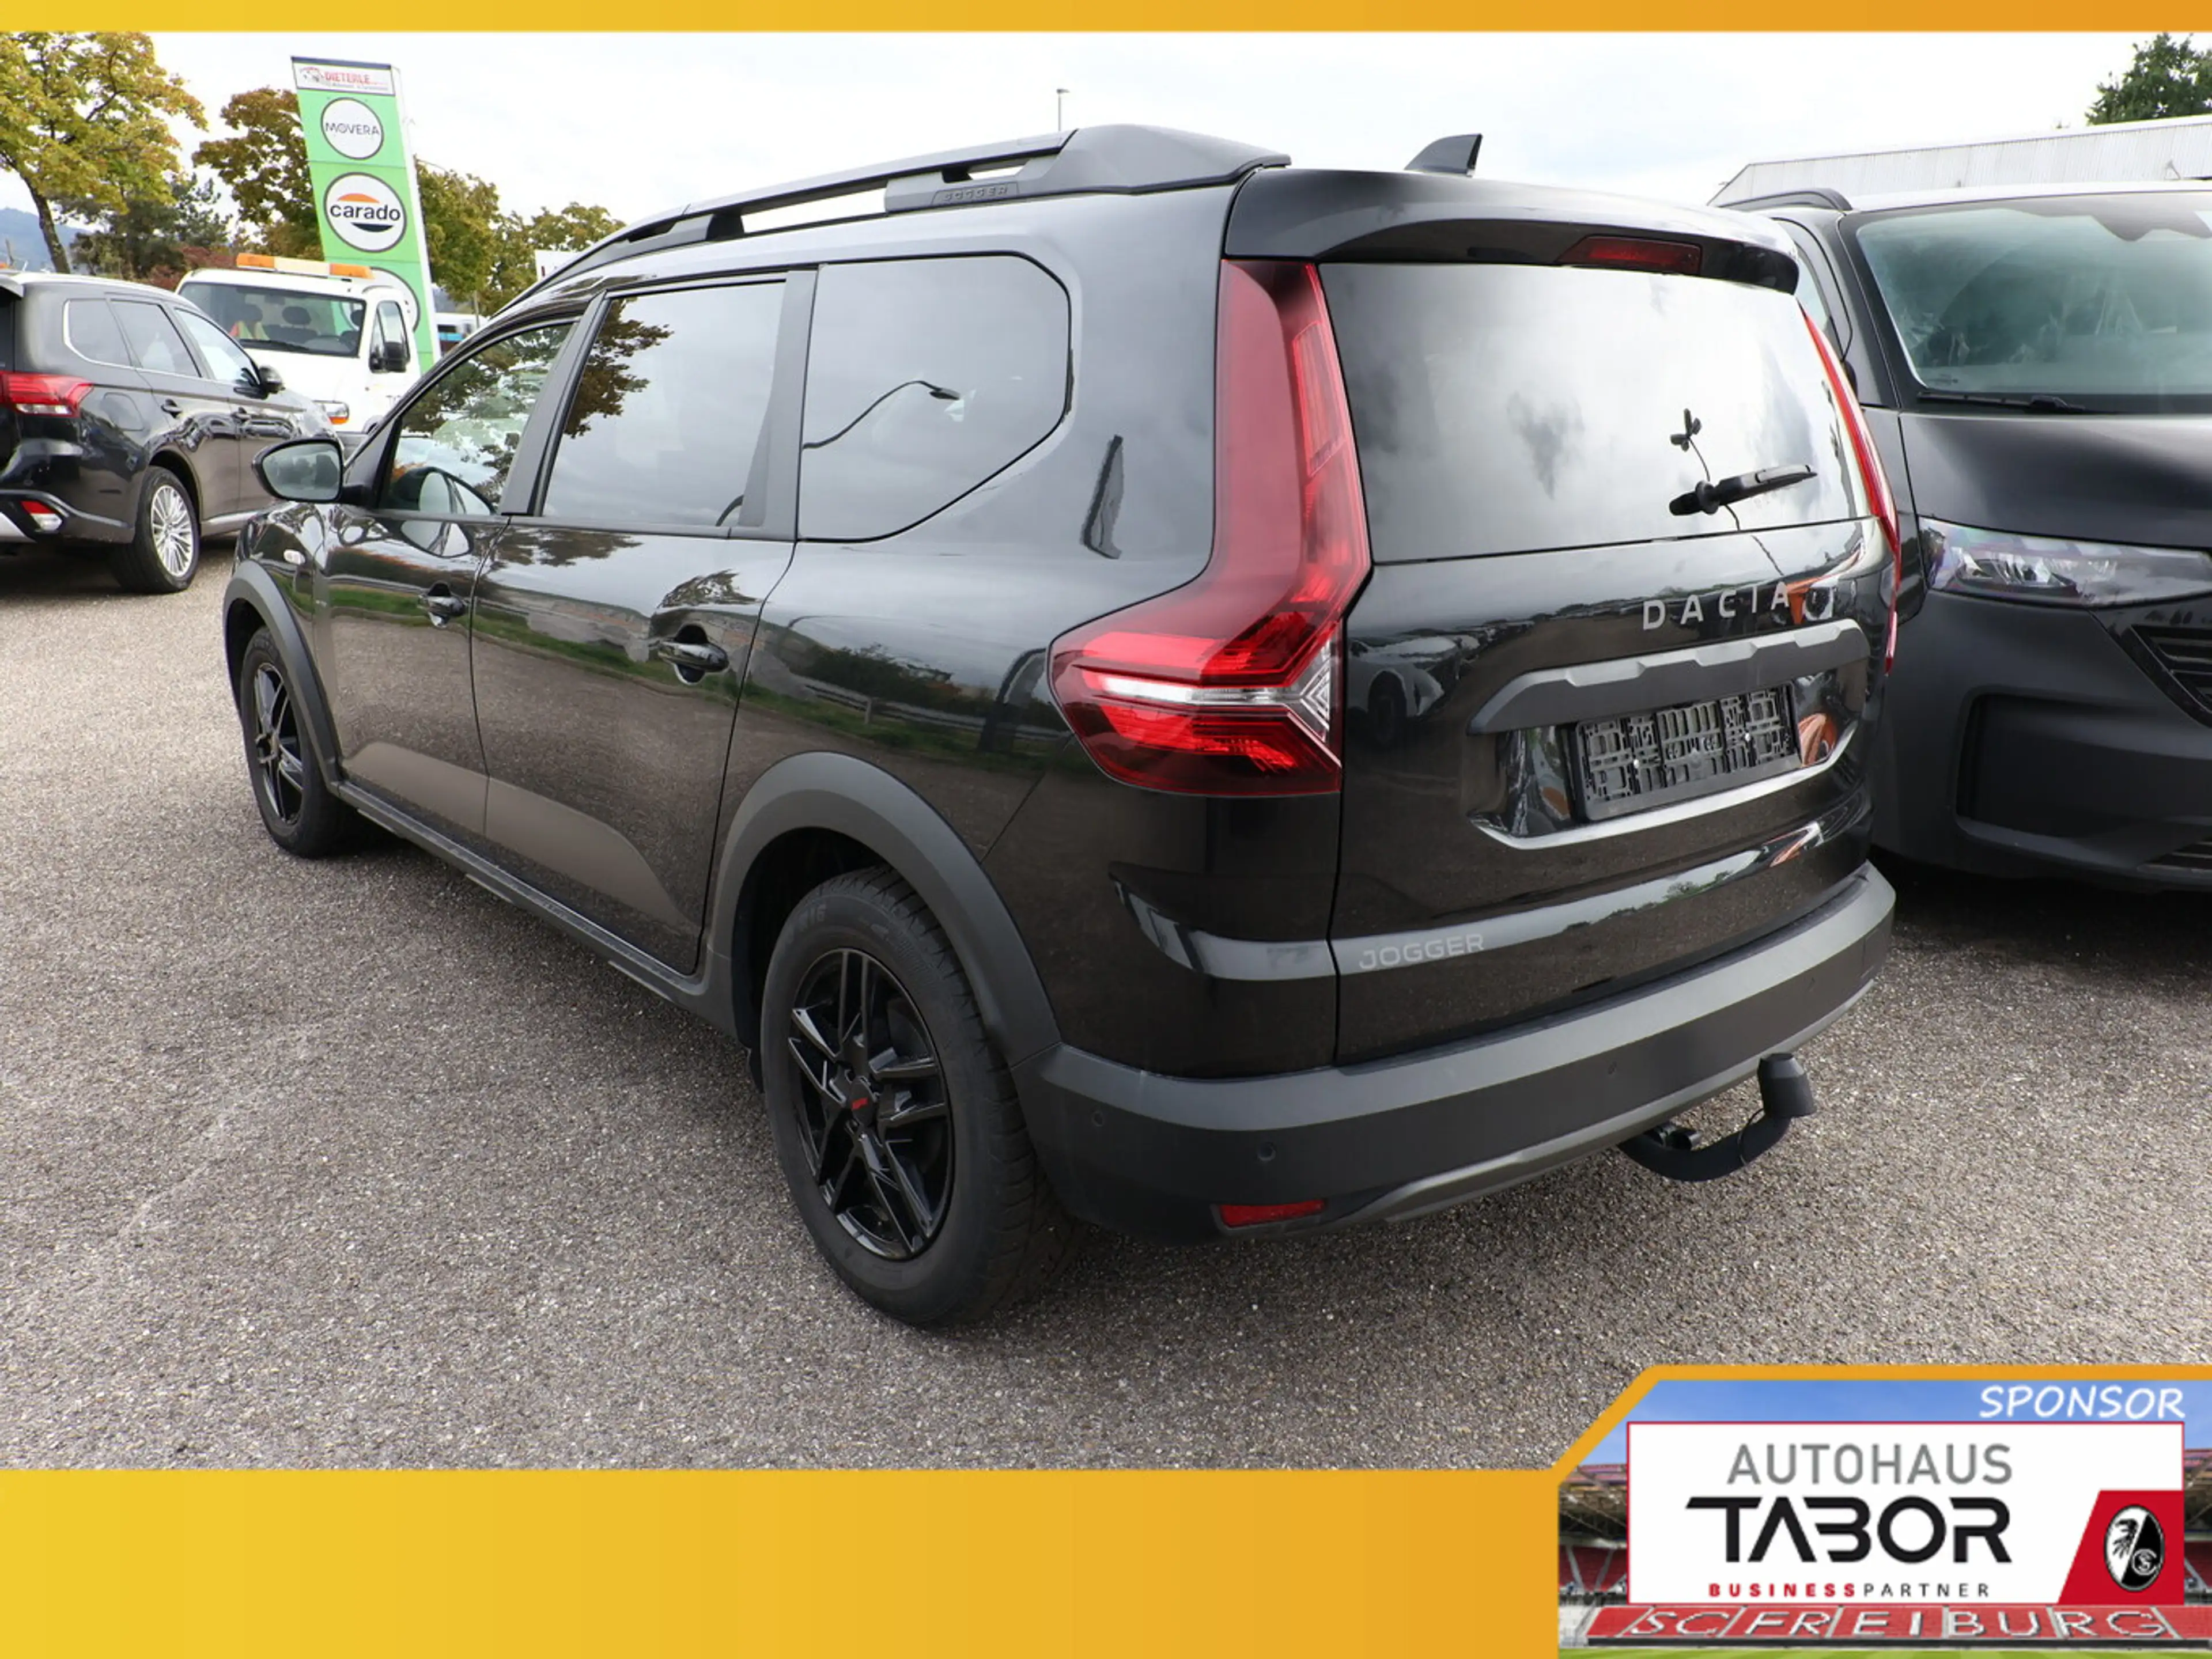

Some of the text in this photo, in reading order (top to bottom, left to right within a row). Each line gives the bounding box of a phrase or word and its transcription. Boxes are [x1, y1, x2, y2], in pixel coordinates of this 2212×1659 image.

[325, 122, 380, 135] MOVERA
[330, 204, 401, 221] carado
[1643, 581, 1789, 631] DACIA
[1359, 934, 1485, 970] JOGGER
